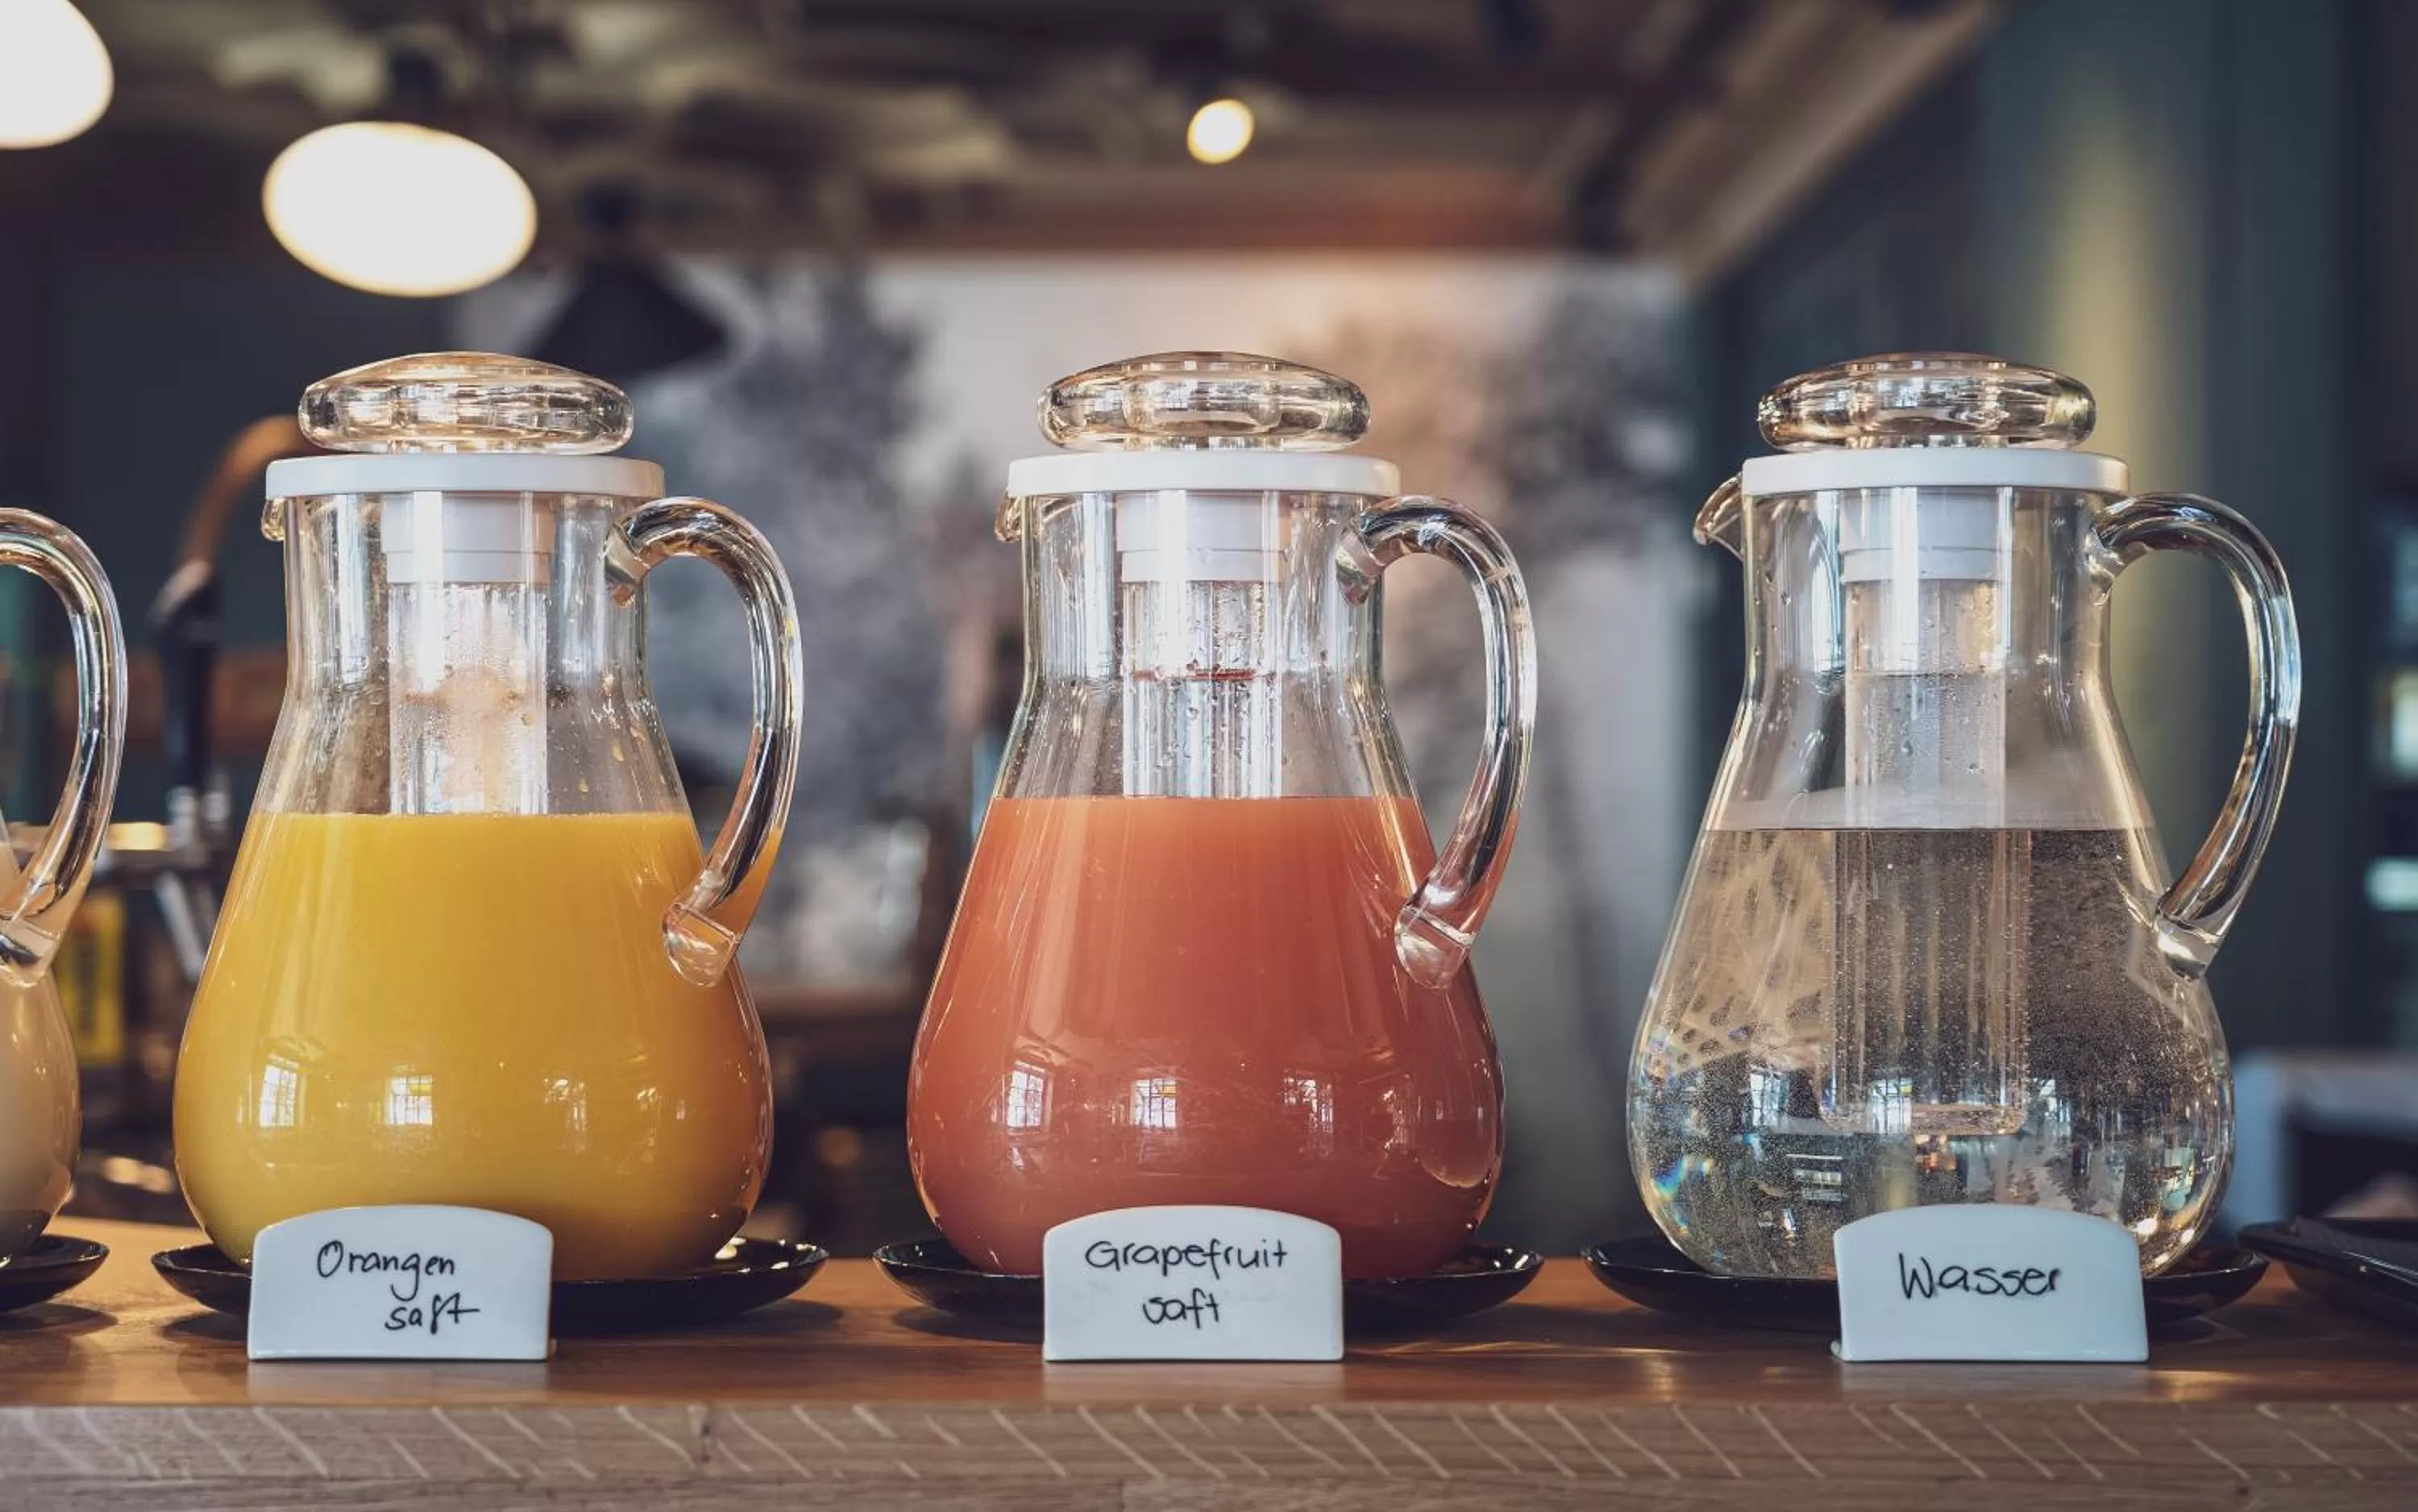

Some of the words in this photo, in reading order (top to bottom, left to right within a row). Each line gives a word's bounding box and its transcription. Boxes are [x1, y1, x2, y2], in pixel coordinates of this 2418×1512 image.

[316, 1239, 455, 1302] Orangen
[1084, 1237, 1289, 1280] Grapefruit
[1897, 1252, 2062, 1300] Wasser
[384, 1291, 480, 1335] saft
[1142, 1286, 1220, 1330] saft
